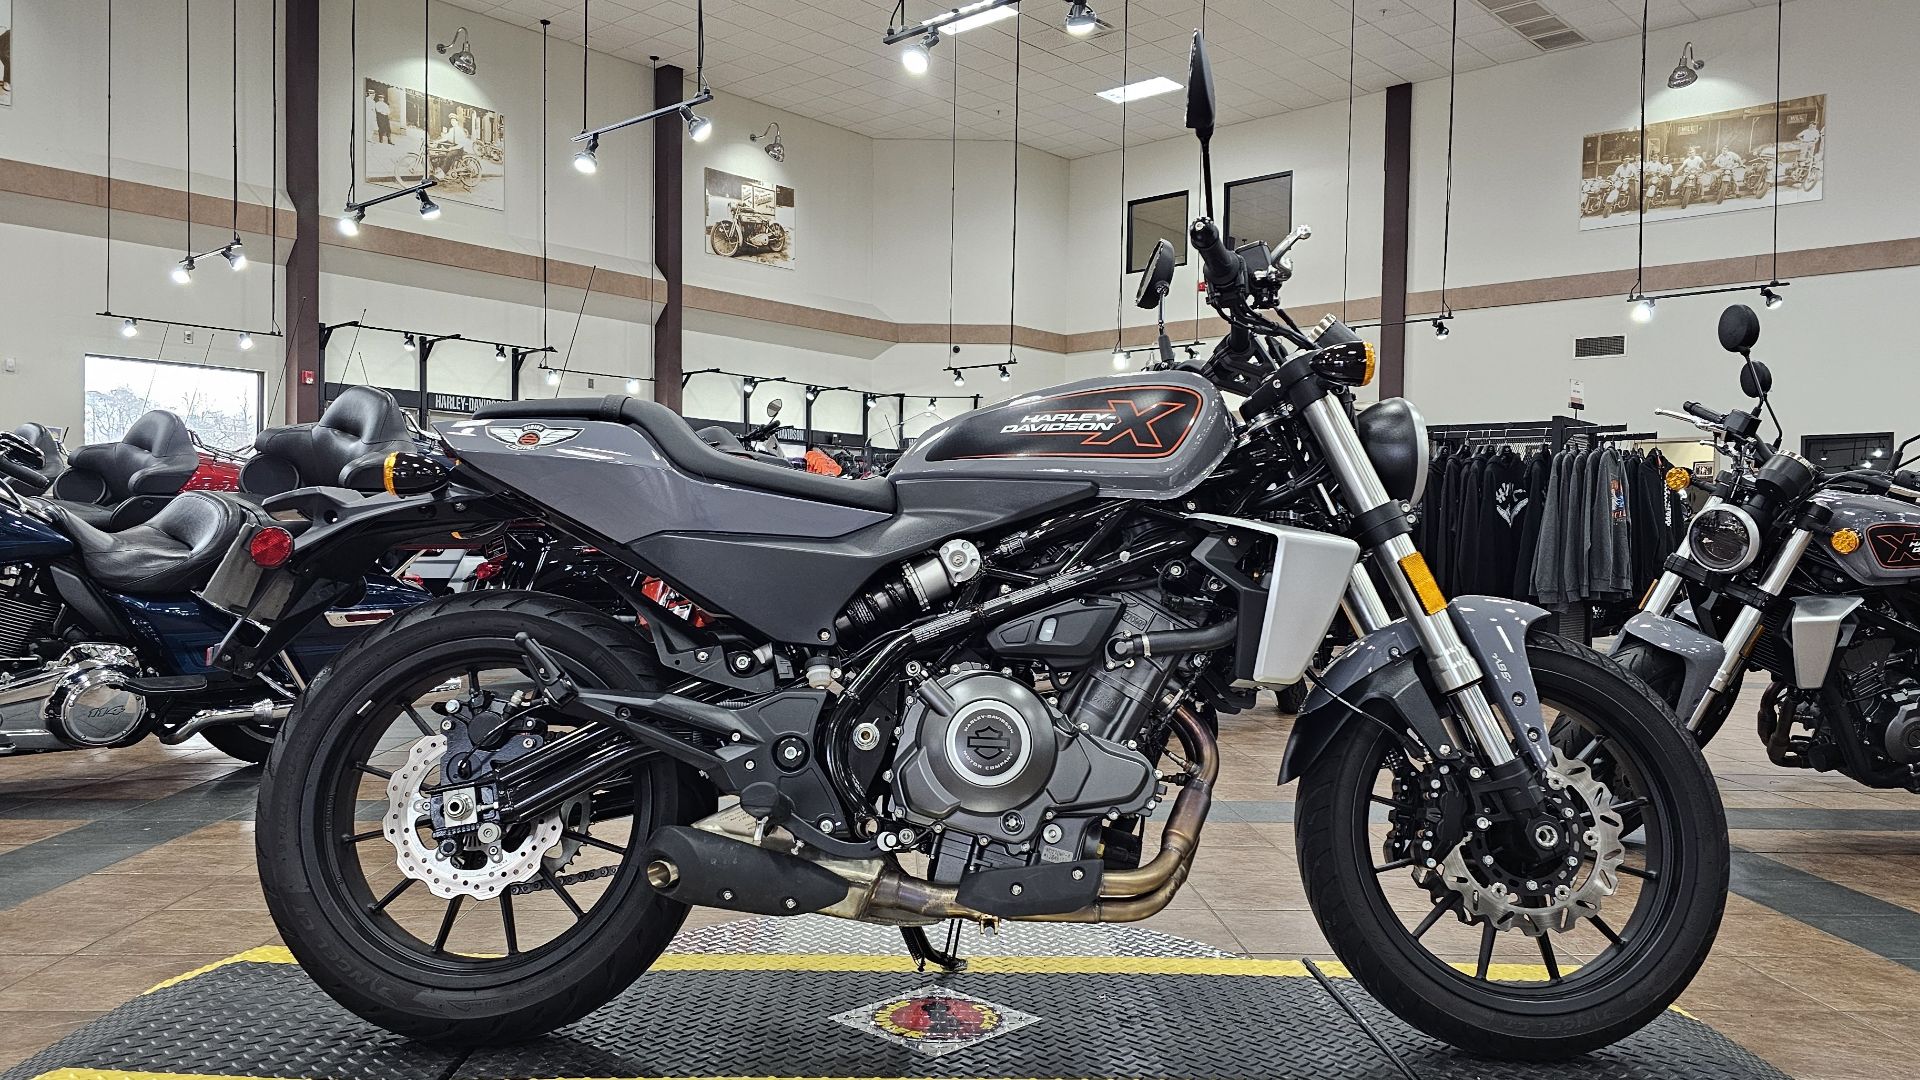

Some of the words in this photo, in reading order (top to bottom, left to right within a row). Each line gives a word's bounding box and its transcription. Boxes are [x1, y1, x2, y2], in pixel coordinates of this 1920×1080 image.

[1020, 413, 1117, 423] HARLEY-
[1080, 399, 1187, 448] X
[1000, 422, 1116, 433] DAVIDSON
[88, 705, 125, 718] 114
[963, 714, 1014, 734] HARLEY-DAVIDSON
[963, 750, 983, 769] MOTOR
[985, 752, 1013, 771] COMPANY
